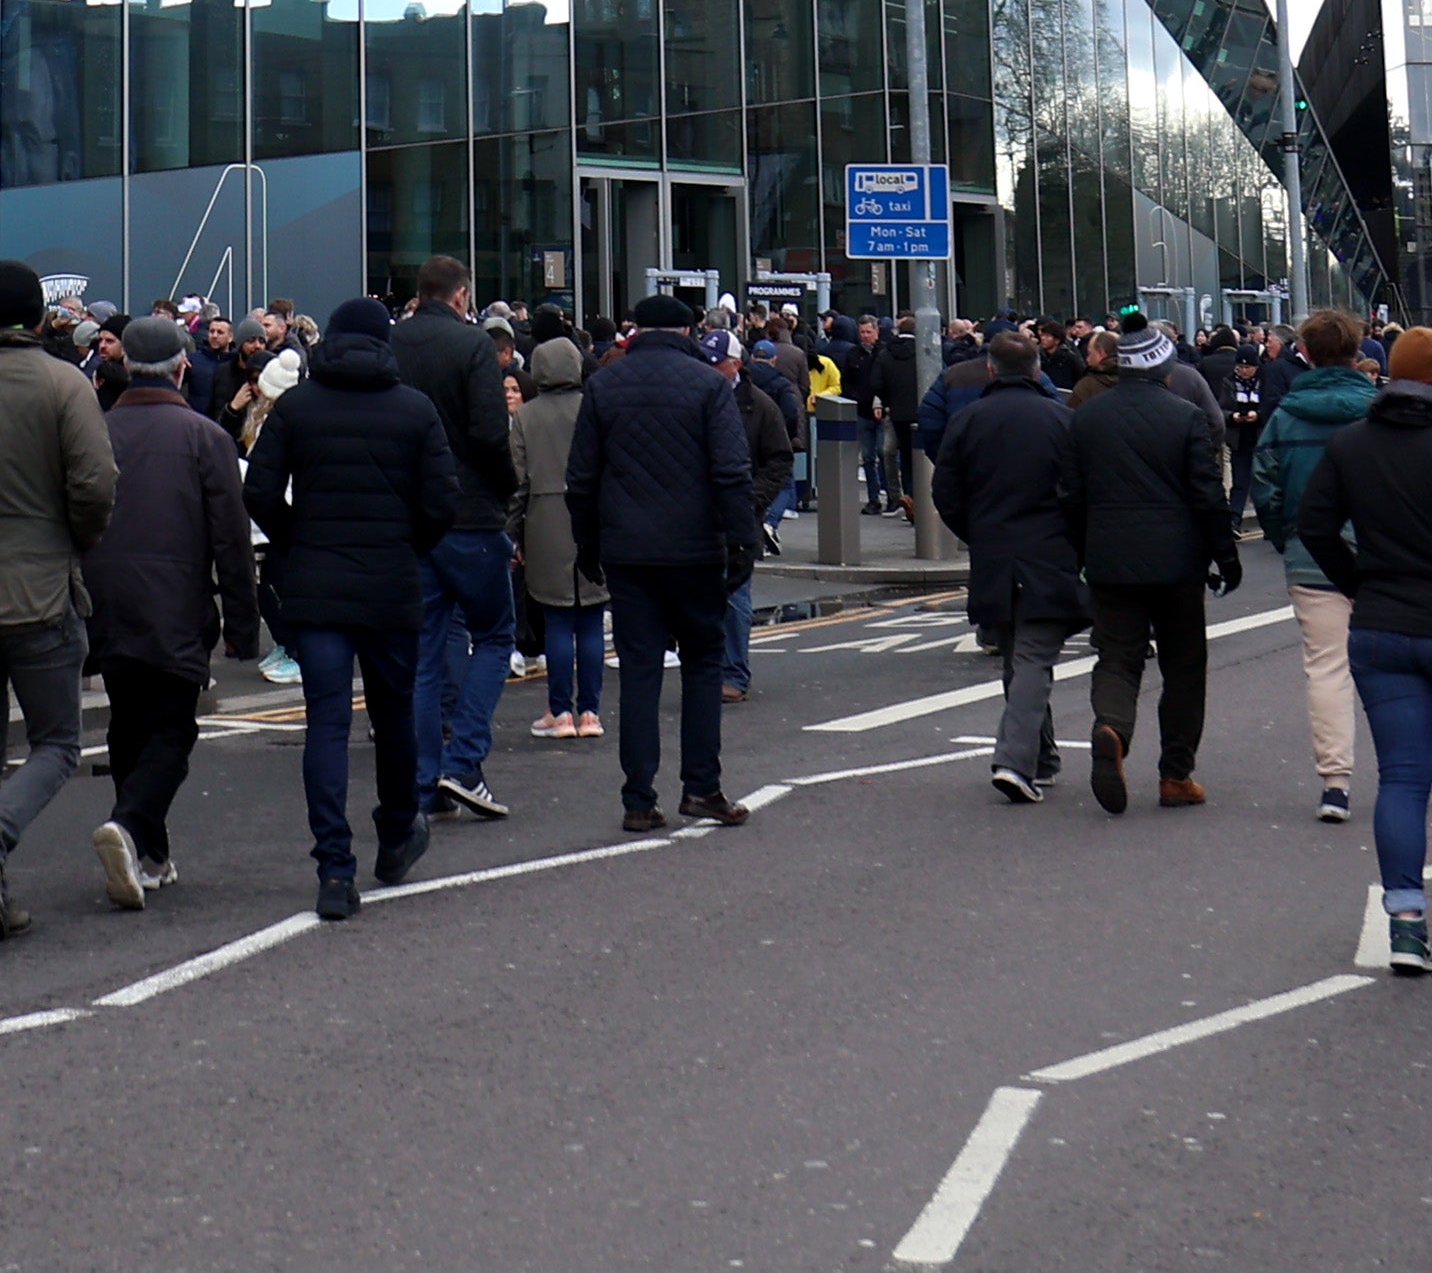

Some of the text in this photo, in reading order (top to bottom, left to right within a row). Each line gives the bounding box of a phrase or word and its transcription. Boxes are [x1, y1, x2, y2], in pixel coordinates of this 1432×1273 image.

[875, 174, 906, 185] local
[888, 200, 912, 212] taxi
[870, 226, 896, 238] Mon
[906, 226, 926, 238] Sat
[748, 286, 802, 297] PROGRAMMES
